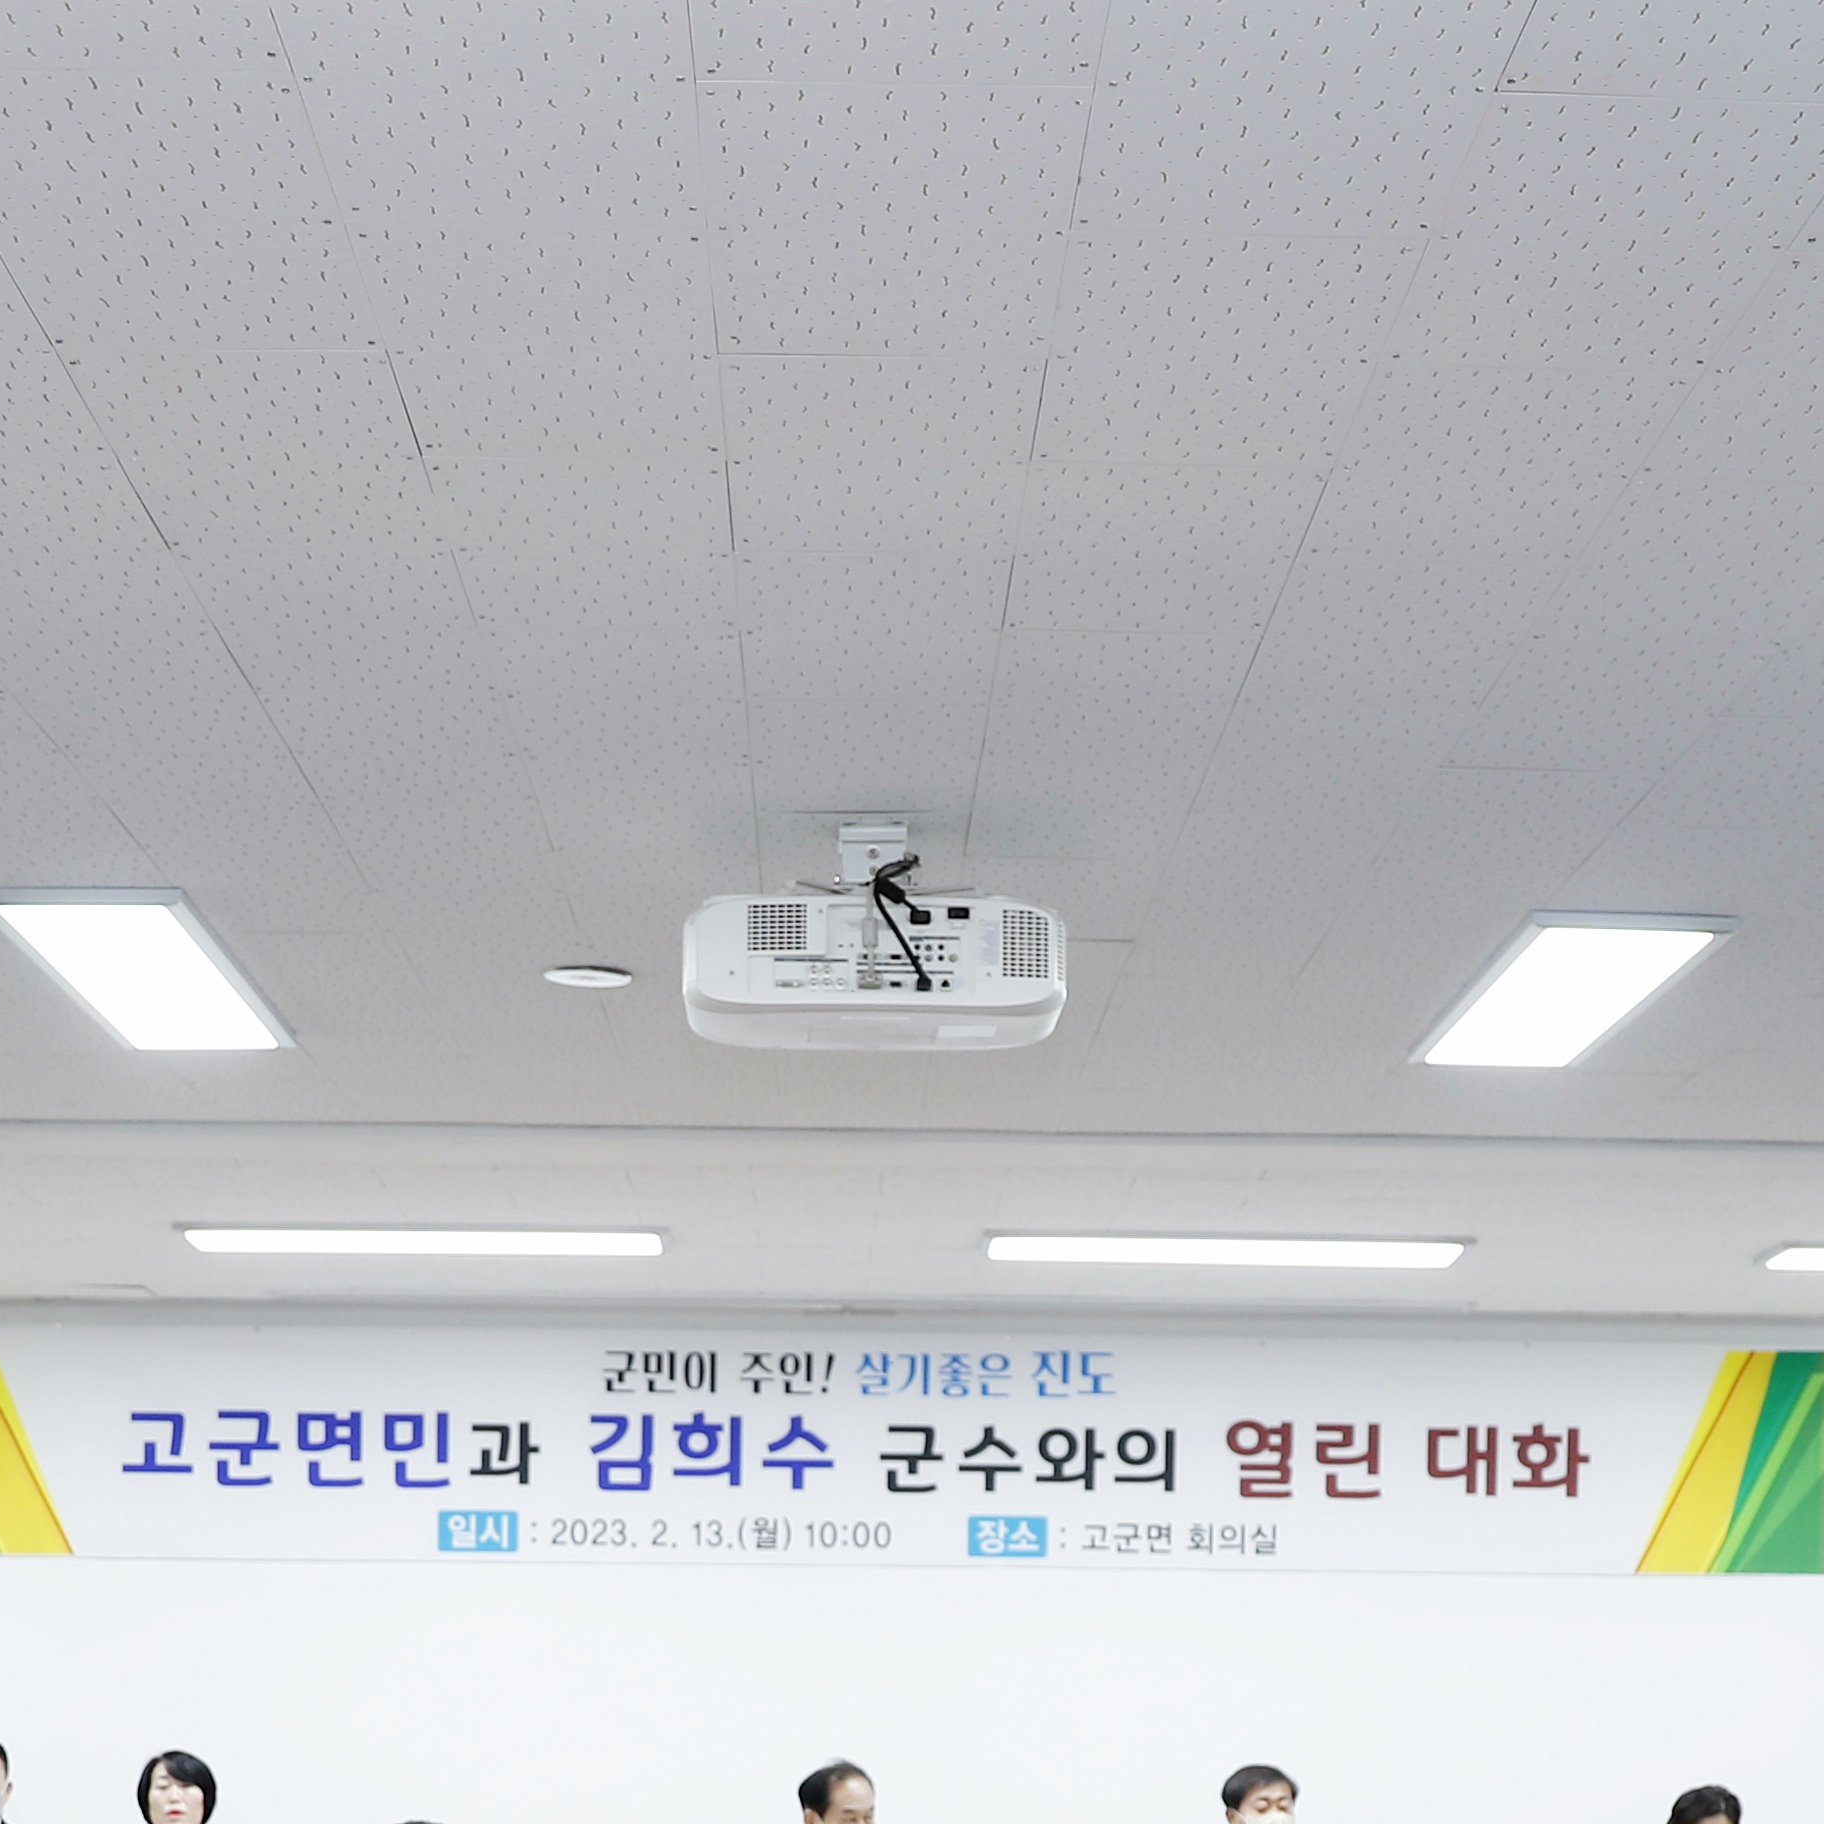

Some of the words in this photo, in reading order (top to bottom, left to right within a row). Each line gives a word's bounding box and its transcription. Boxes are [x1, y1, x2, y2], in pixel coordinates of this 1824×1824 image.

[602, 1350, 716, 1394] 군민이
[740, 1351, 836, 1394] 주인!
[856, 1352, 1011, 1397] 살기좋은
[1032, 1350, 1117, 1397] 진도
[123, 1411, 539, 1488] 고군면민과
[590, 1411, 834, 1491] 김희수
[879, 1425, 1176, 1493] 군수와의
[1226, 1420, 1382, 1499] 열린
[1427, 1424, 1590, 1498] 대화
[446, 1513, 511, 1548] 일시
[550, 1518, 637, 1548] 2023.
[806, 1520, 891, 1548] 10:00
[976, 1520, 1041, 1555] 장소
[1081, 1523, 1173, 1554] 고군면
[1187, 1523, 1278, 1555] 회의실
